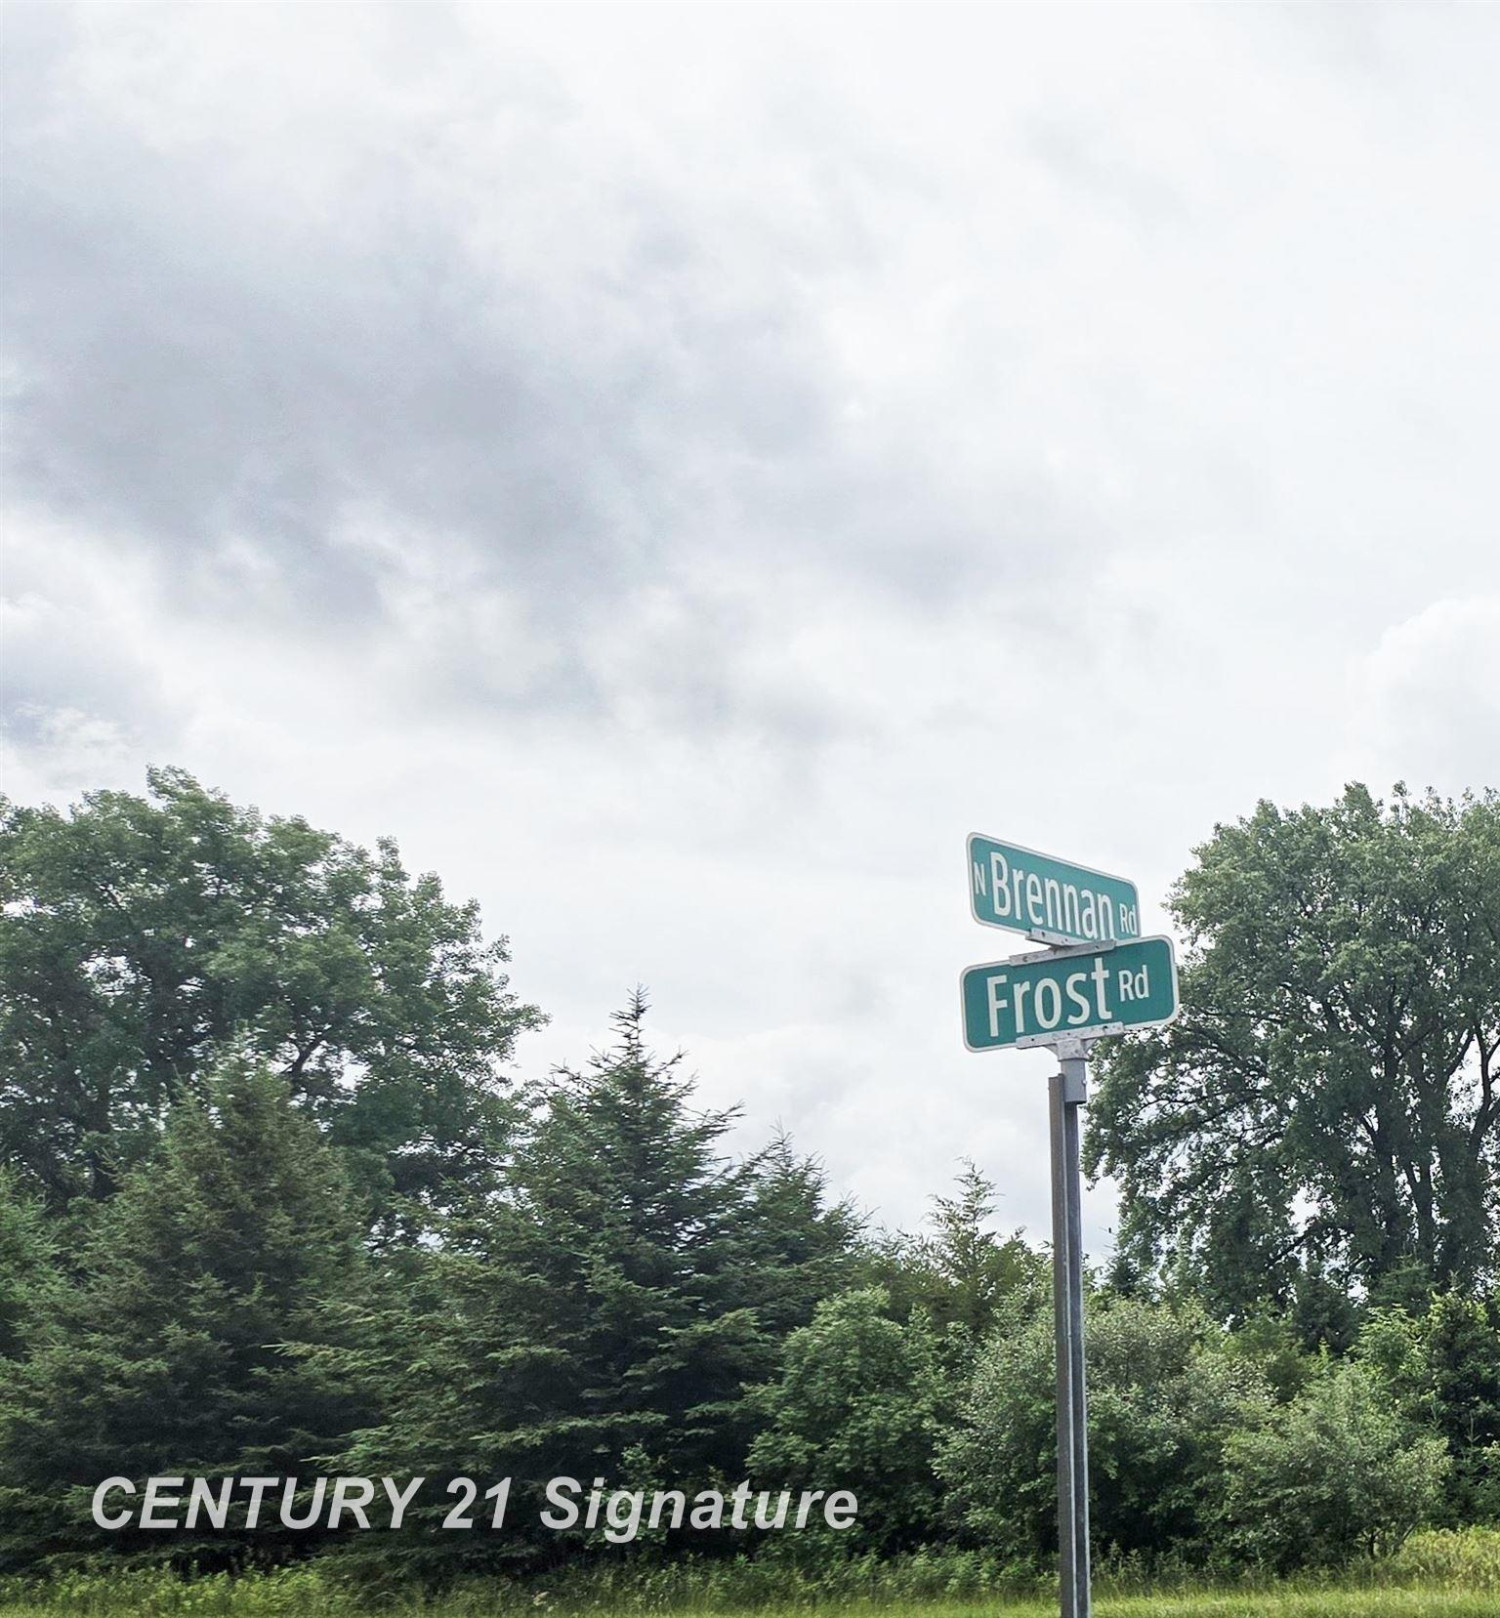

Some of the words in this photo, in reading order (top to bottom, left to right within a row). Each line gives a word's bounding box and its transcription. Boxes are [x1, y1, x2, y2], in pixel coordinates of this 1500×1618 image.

[973, 862, 986, 897] N
[990, 852, 1115, 941] Brennan
[1120, 903, 1138, 935] Rd
[987, 957, 1112, 1037] Frost
[1118, 965, 1149, 1002] Rd
